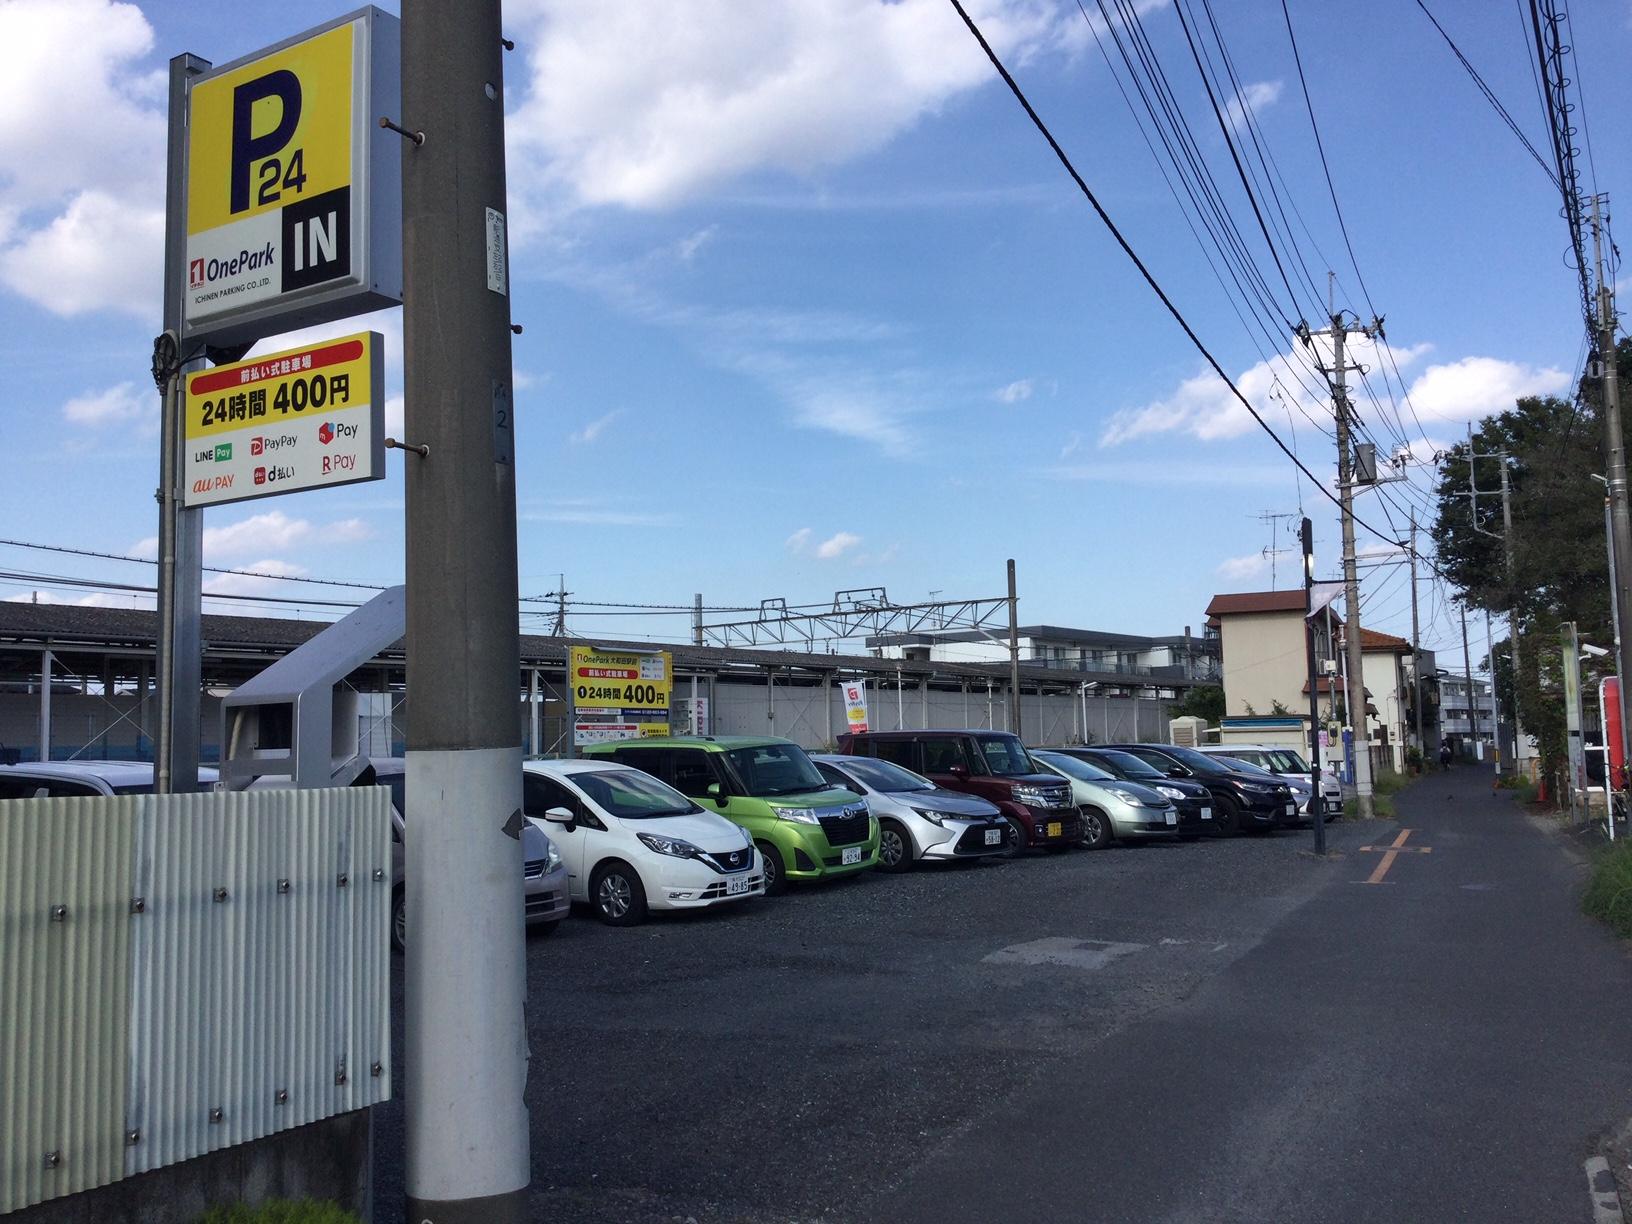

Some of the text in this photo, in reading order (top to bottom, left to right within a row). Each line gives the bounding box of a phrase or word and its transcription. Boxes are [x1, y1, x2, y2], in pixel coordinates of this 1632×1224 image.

[230, 69, 302, 215] P
[258, 148, 307, 206] 24
[294, 211, 337, 272] IN
[207, 242, 275, 281] OnePark
[194, 291, 219, 304] ICHINEN
[219, 284, 246, 298] PARKING
[240, 354, 312, 383] 前払い式駐車場
[201, 373, 350, 427] 24時間 400円
[497, 410, 508, 429] 2
[336, 423, 358, 439] Pay
[264, 435, 298, 451] PayPay
[195, 448, 231, 463] LINE Pay
[322, 454, 356, 475] R Pay
[193, 474, 235, 493] au PAY
[268, 465, 295, 482] d払い
[588, 687, 621, 700] 24時間
[623, 685, 665, 704] 400円
